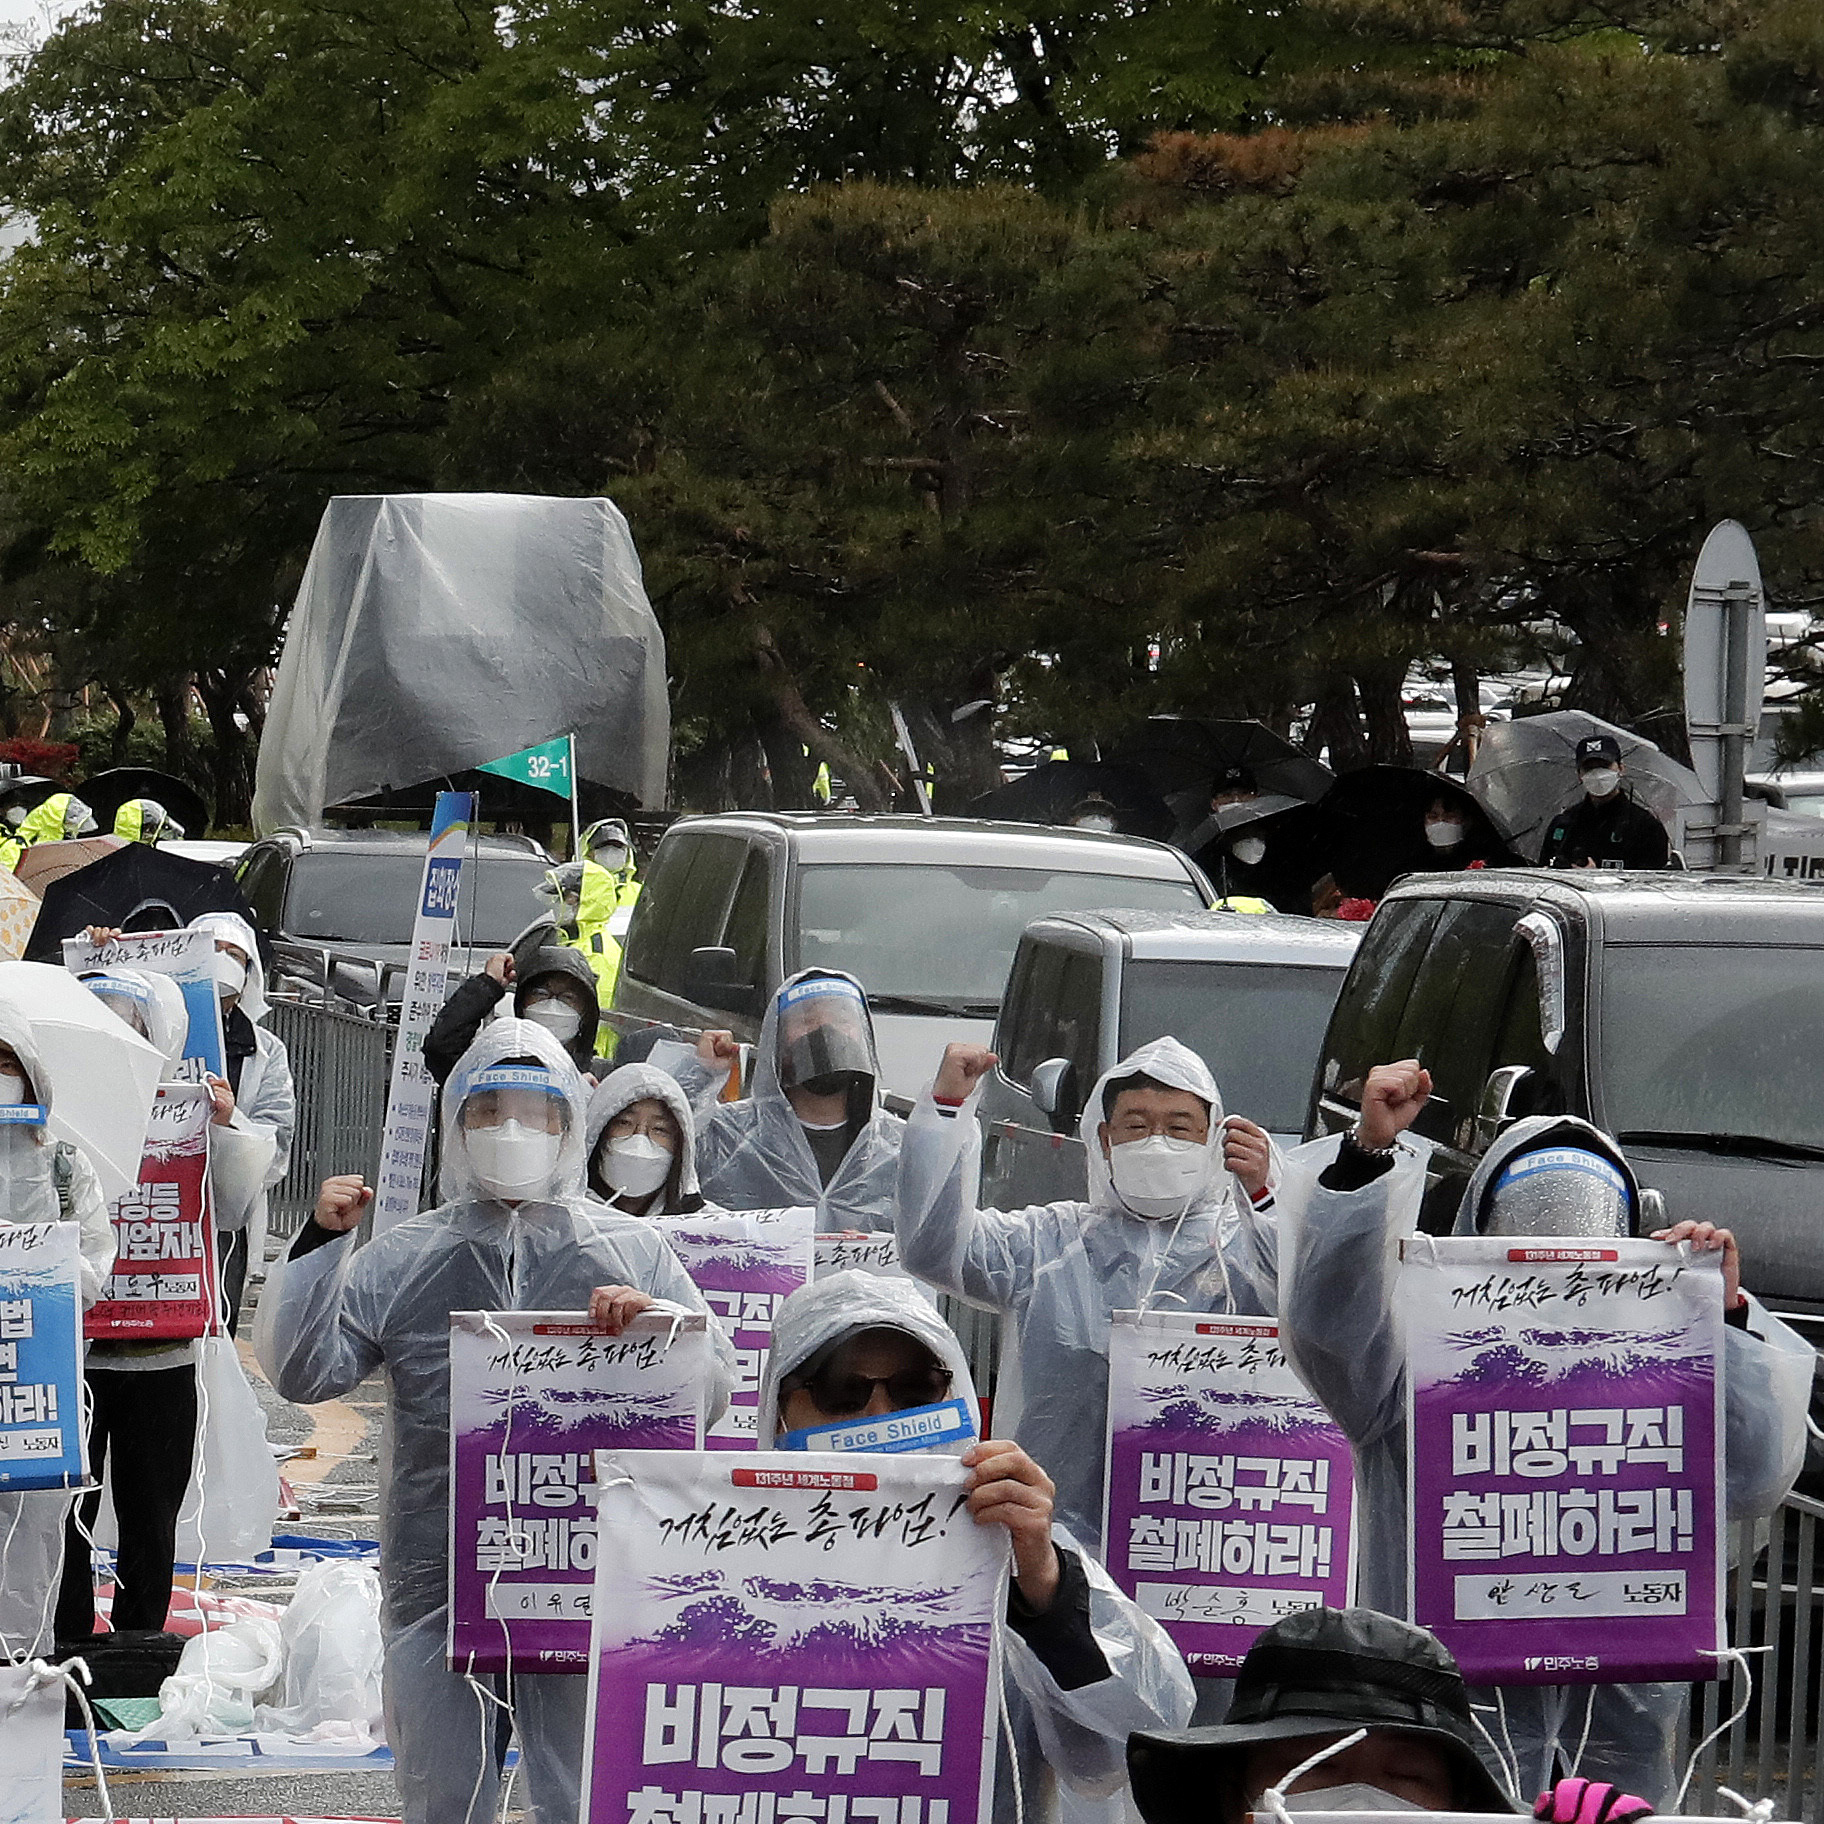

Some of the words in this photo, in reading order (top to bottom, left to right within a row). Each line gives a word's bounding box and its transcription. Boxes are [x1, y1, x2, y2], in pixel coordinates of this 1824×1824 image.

[528, 755, 568, 778] 32-1
[1452, 1272, 1554, 1313] 거침없는
[22, 1434, 60, 1453] 노동자
[829, 1430, 879, 1450] Face
[886, 1414, 943, 1440] Shield
[1451, 1403, 1685, 1479] 비정규직
[754, 1470, 794, 1488] 131주년
[796, 1471, 855, 1490] 세계노동절
[1139, 1451, 1330, 1514] 비정규직
[658, 1503, 798, 1556] 거침없는
[1441, 1486, 1694, 1562] 철폐하라!
[1127, 1514, 1333, 1579] 철폐하라!
[1622, 1582, 1683, 1606] 노동자
[1544, 1654, 1601, 1672] 민주노총
[642, 1681, 948, 1777] 비정규직
